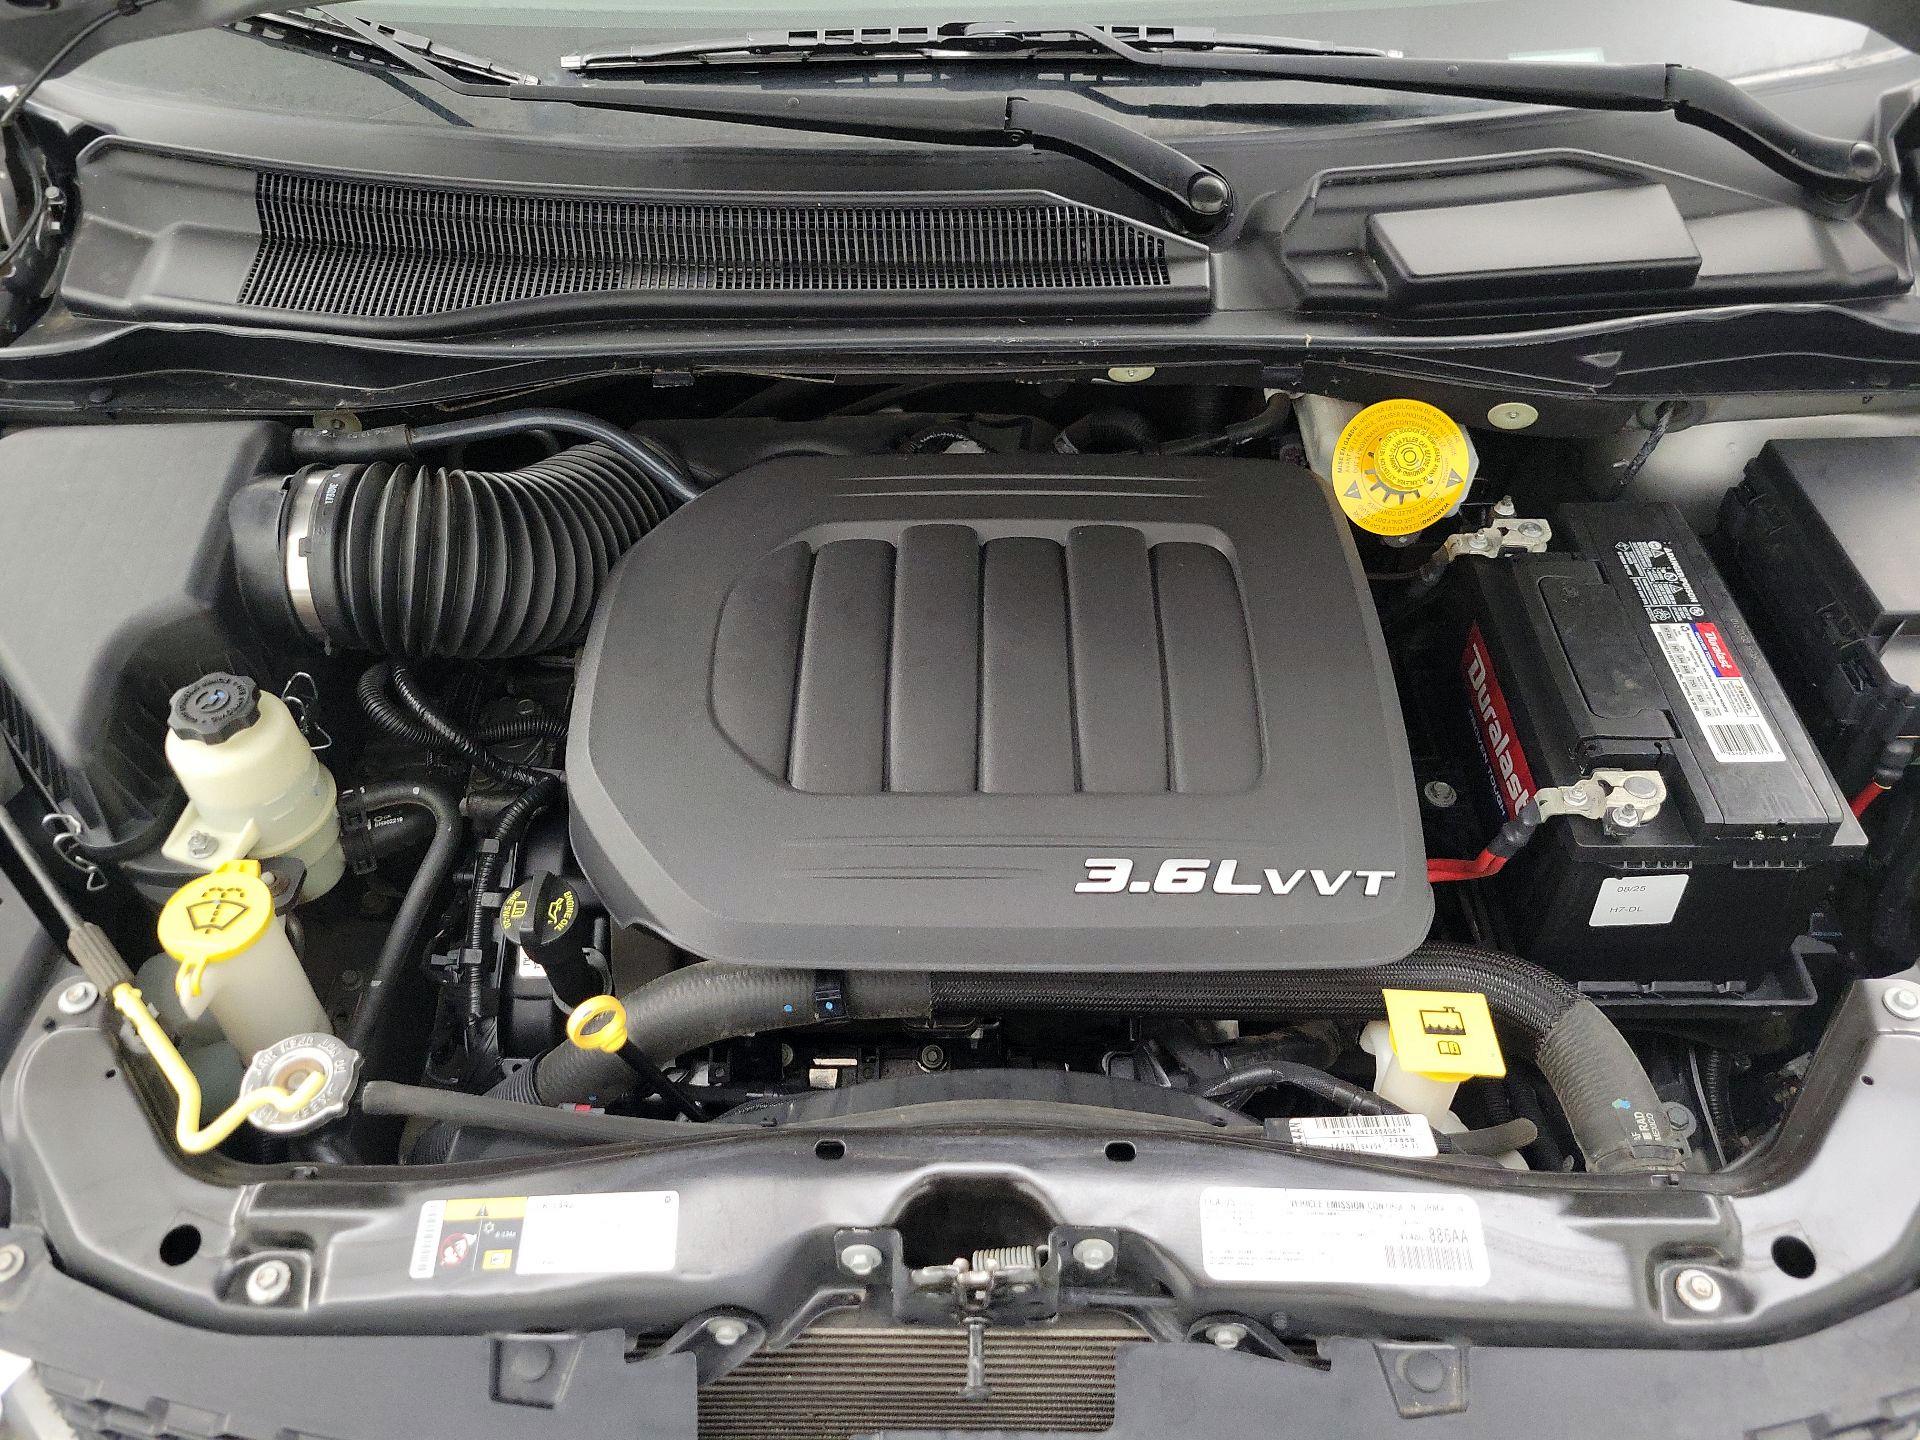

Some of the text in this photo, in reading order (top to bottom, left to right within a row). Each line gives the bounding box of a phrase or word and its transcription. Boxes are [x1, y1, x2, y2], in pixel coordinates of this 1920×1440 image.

[1703, 630, 1732, 669] Duralast
[1466, 642, 1532, 817] Duralast
[1263, 868, 1397, 897] VVT
